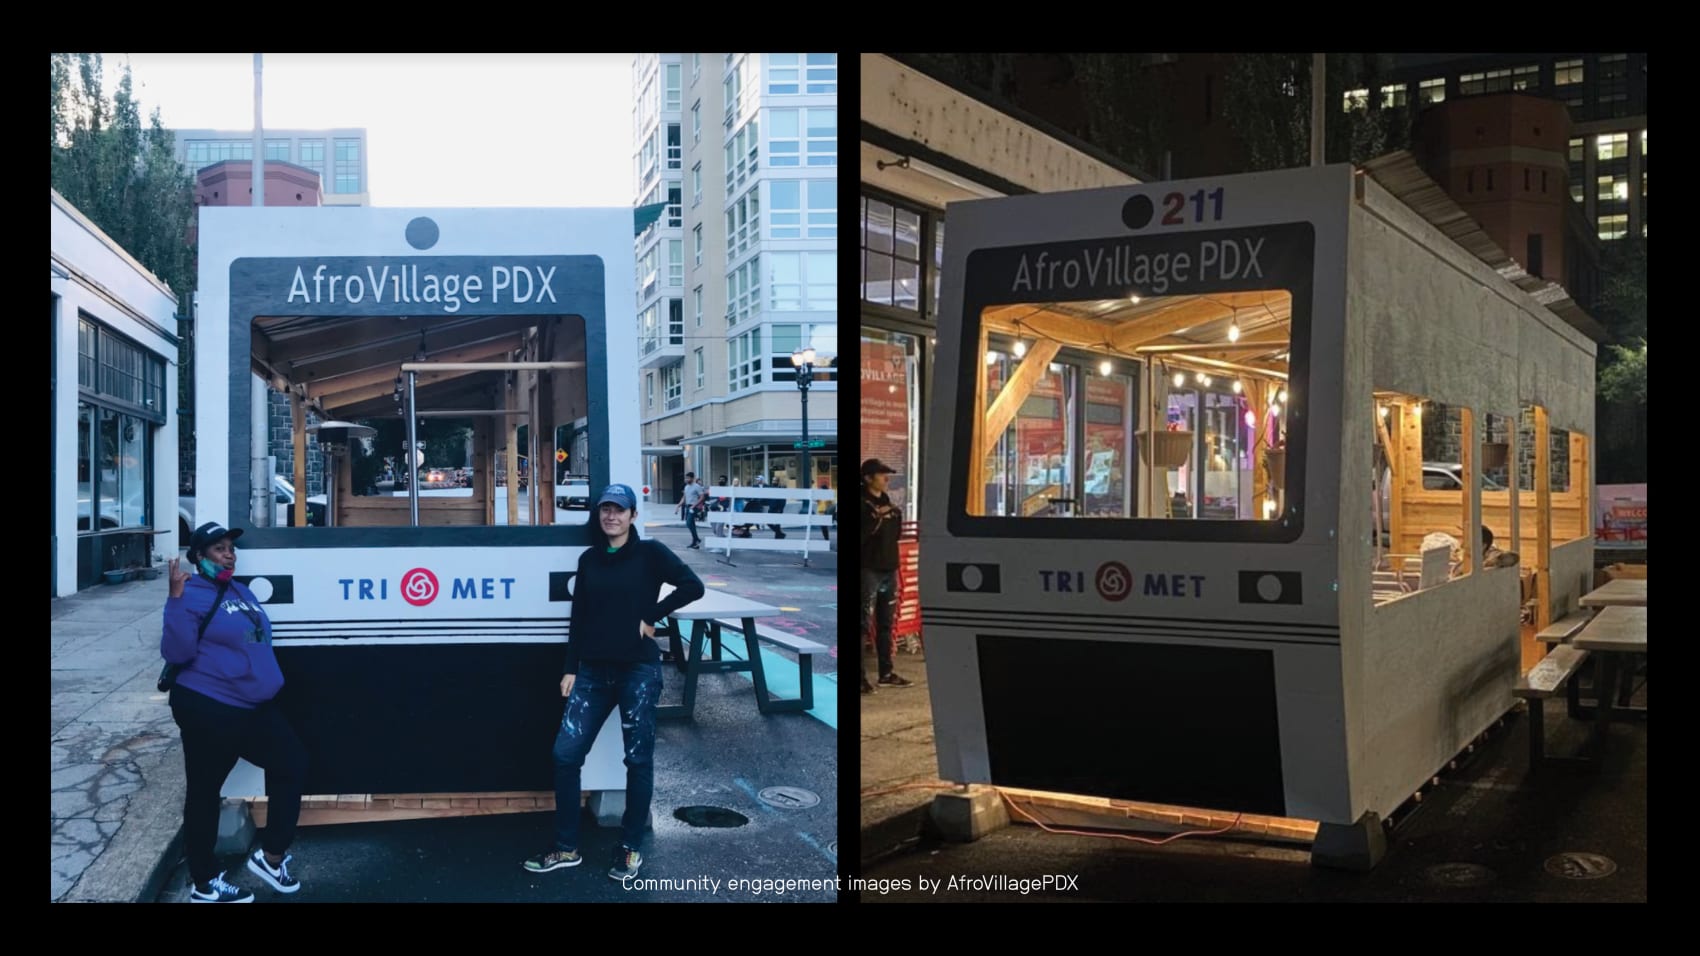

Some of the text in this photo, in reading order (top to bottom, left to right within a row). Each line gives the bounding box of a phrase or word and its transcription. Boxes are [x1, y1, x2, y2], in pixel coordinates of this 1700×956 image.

[1161, 187, 1224, 225] 211
[1012, 238, 1265, 294] AfroVillage PDX
[287, 264, 557, 313] AfroVillage PDX
[338, 578, 516, 600] TRI MET
[1038, 570, 1206, 598] TRI MET
